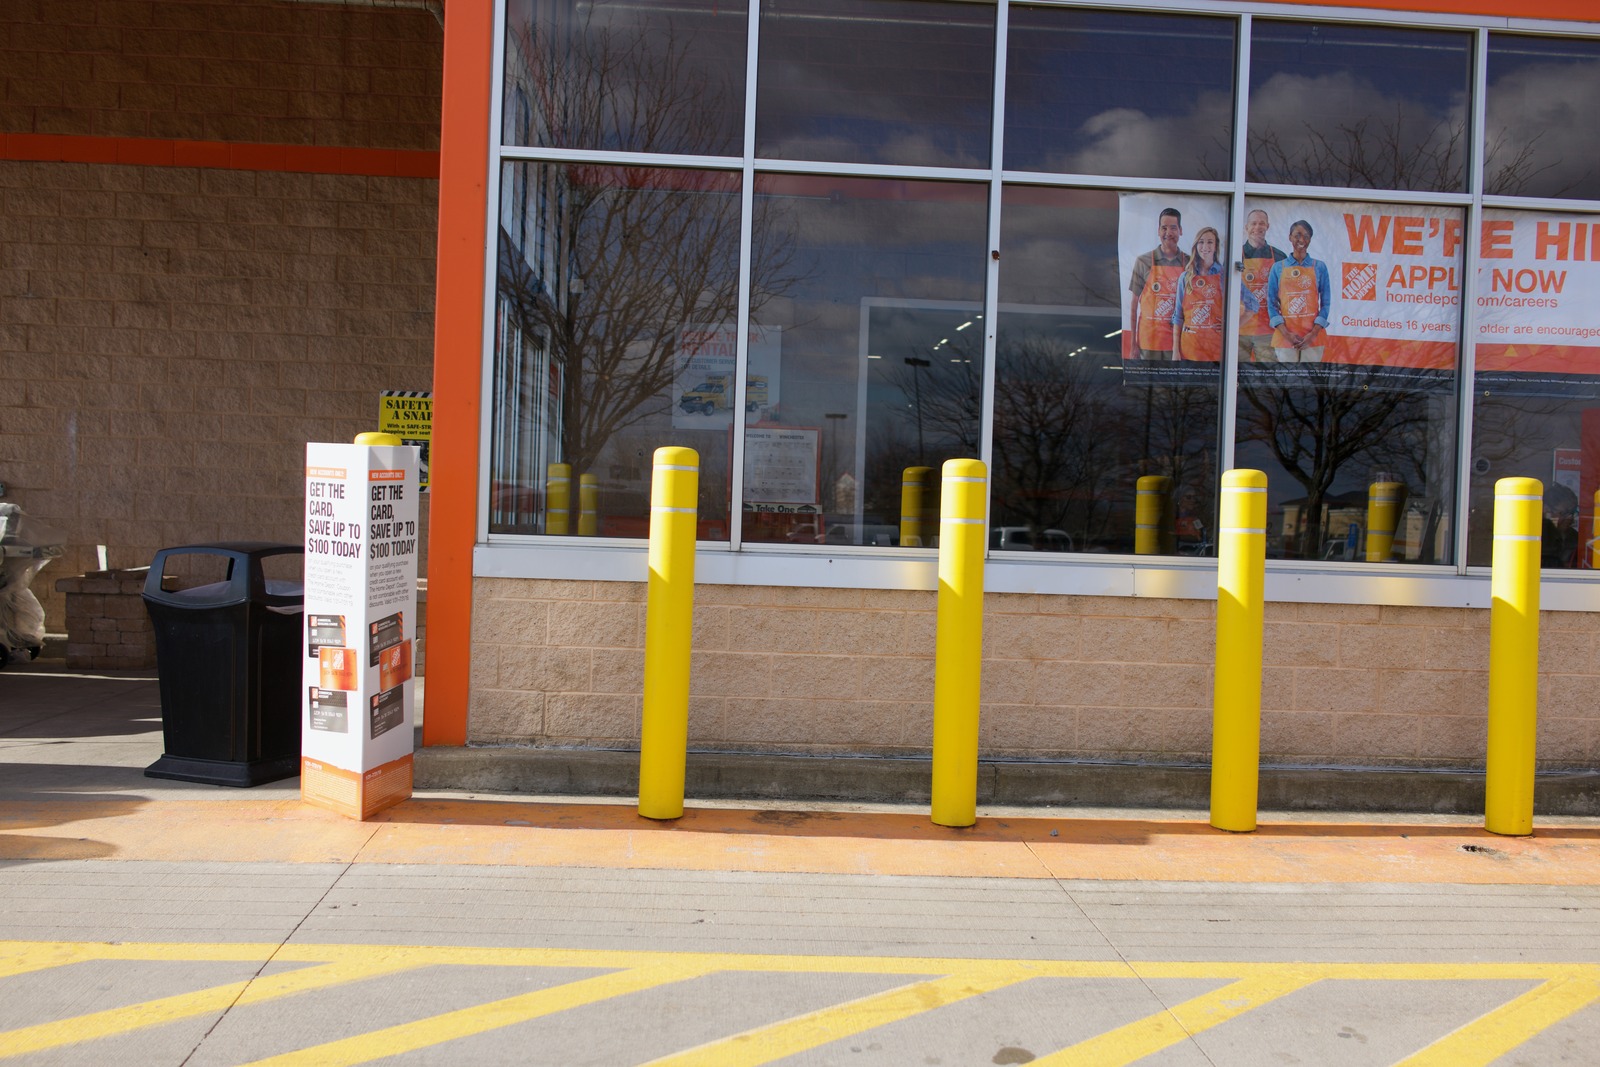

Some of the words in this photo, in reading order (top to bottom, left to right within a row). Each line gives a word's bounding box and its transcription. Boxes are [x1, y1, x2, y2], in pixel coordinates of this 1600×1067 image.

[1535, 221, 1600, 262] HI
[1342, 263, 1377, 300] HOME
[1345, 266, 1360, 281] THE
[1386, 264, 1482, 292] APPL
[1491, 268, 1567, 294] NOW
[1355, 277, 1376, 301] DEPOT
[1386, 291, 1558, 309] homedepoom/careers
[1341, 315, 1403, 330] Candidates
[1406, 320, 1418, 330] 16
[1421, 321, 1452, 334] years
[1479, 323, 1510, 334] older
[1514, 326, 1534, 335] are
[392, 410, 400, 420] A
[309, 481, 326, 498] GET
[328, 483, 345, 499] THE
[371, 485, 387, 501] GET
[389, 485, 403, 500] THE
[309, 500, 335, 521] CARD,
[370, 504, 394, 522] CARD,
[756, 504, 776, 513] Take
[777, 504, 795, 513] One
[308, 518, 331, 536] SAVE
[333, 521, 346, 537] UP
[348, 523, 361, 539] TO
[370, 523, 391, 540] SAVE
[393, 522, 403, 538] UP
[405, 520, 415, 536] TO
[308, 538, 329, 555] $100
[331, 540, 361, 559] TODAY
[370, 542, 390, 560] $100
[391, 539, 416, 557] TODAY
